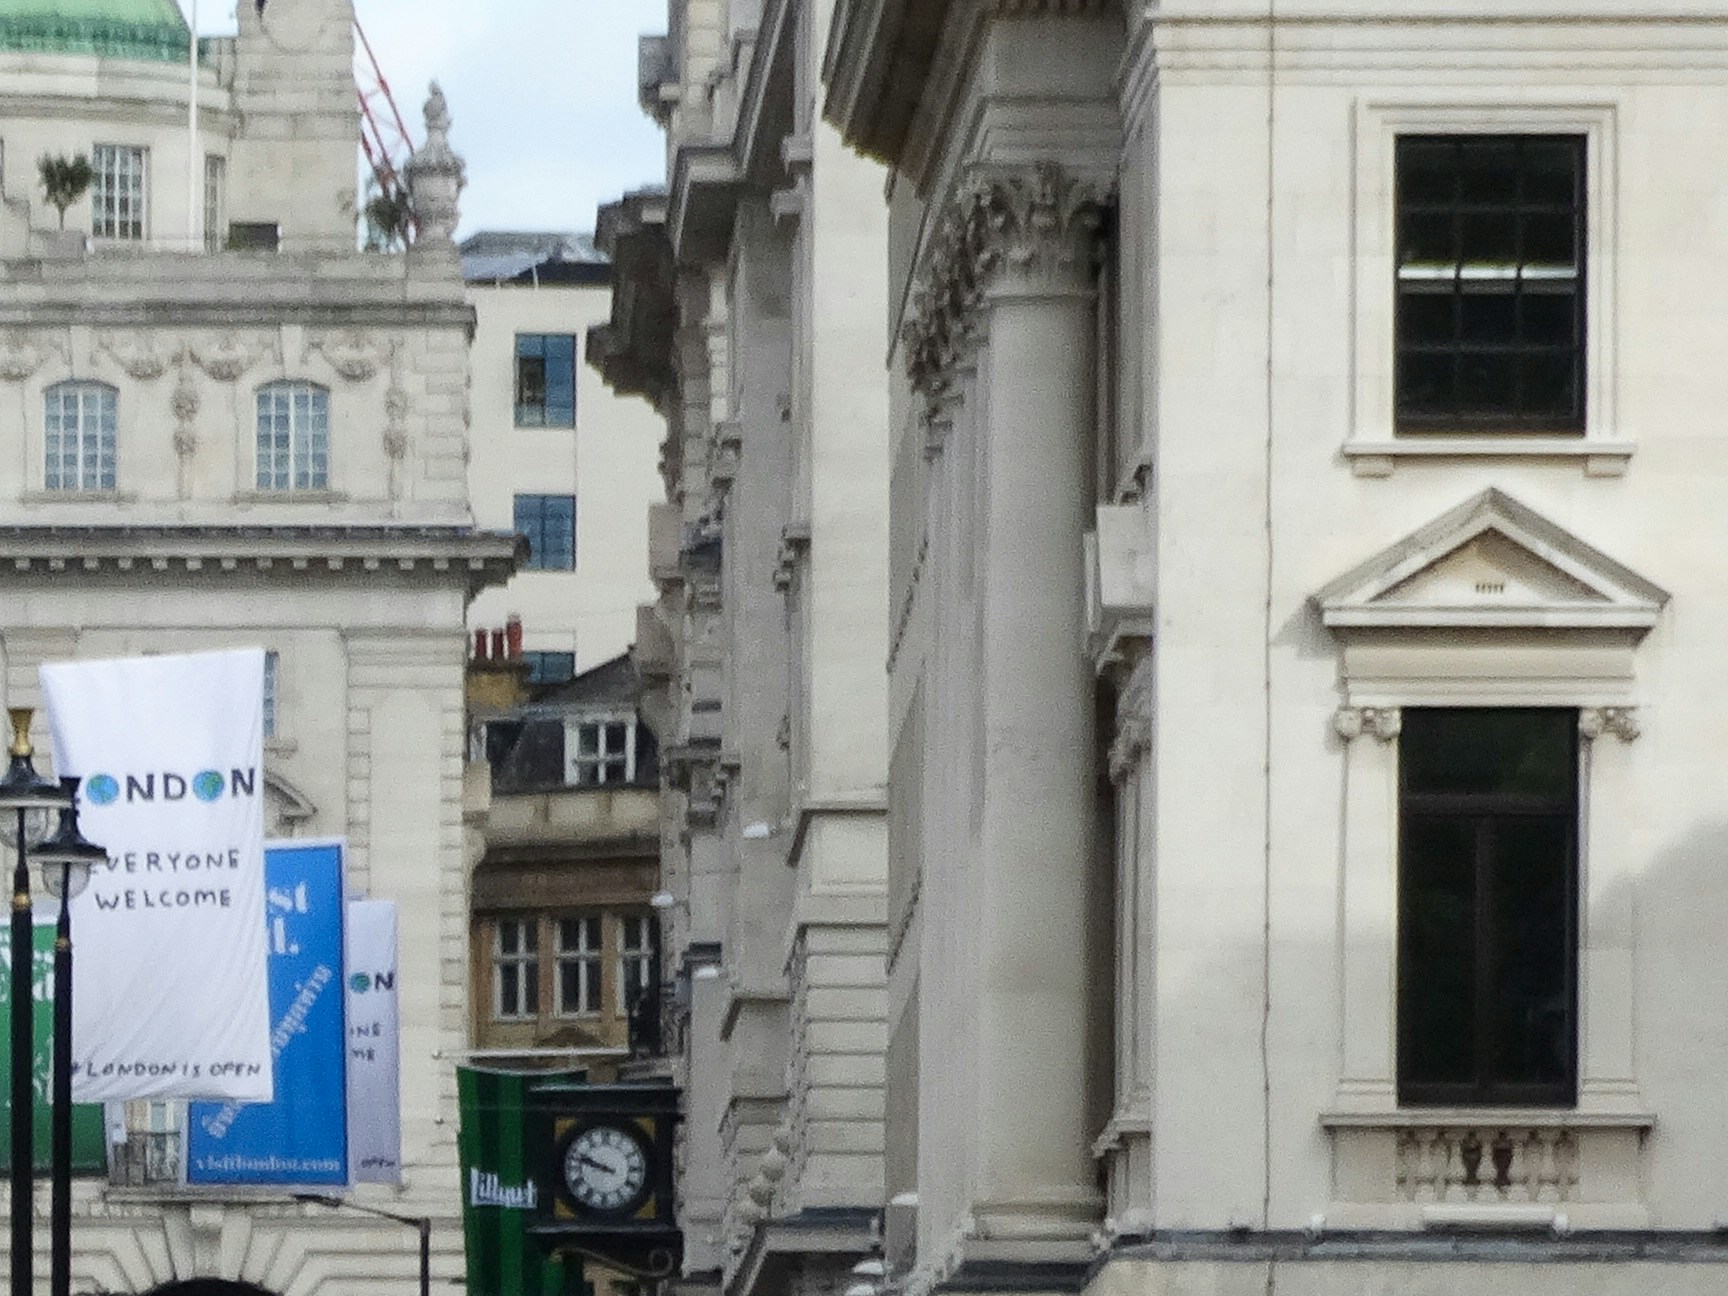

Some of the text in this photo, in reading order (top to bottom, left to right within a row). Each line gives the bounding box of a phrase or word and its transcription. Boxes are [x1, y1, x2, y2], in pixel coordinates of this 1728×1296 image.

[85, 768, 257, 806] ONDON
[95, 889, 232, 911] WELCOME
[266, 881, 308, 914] st
[209, 1062, 261, 1077] OPEN
